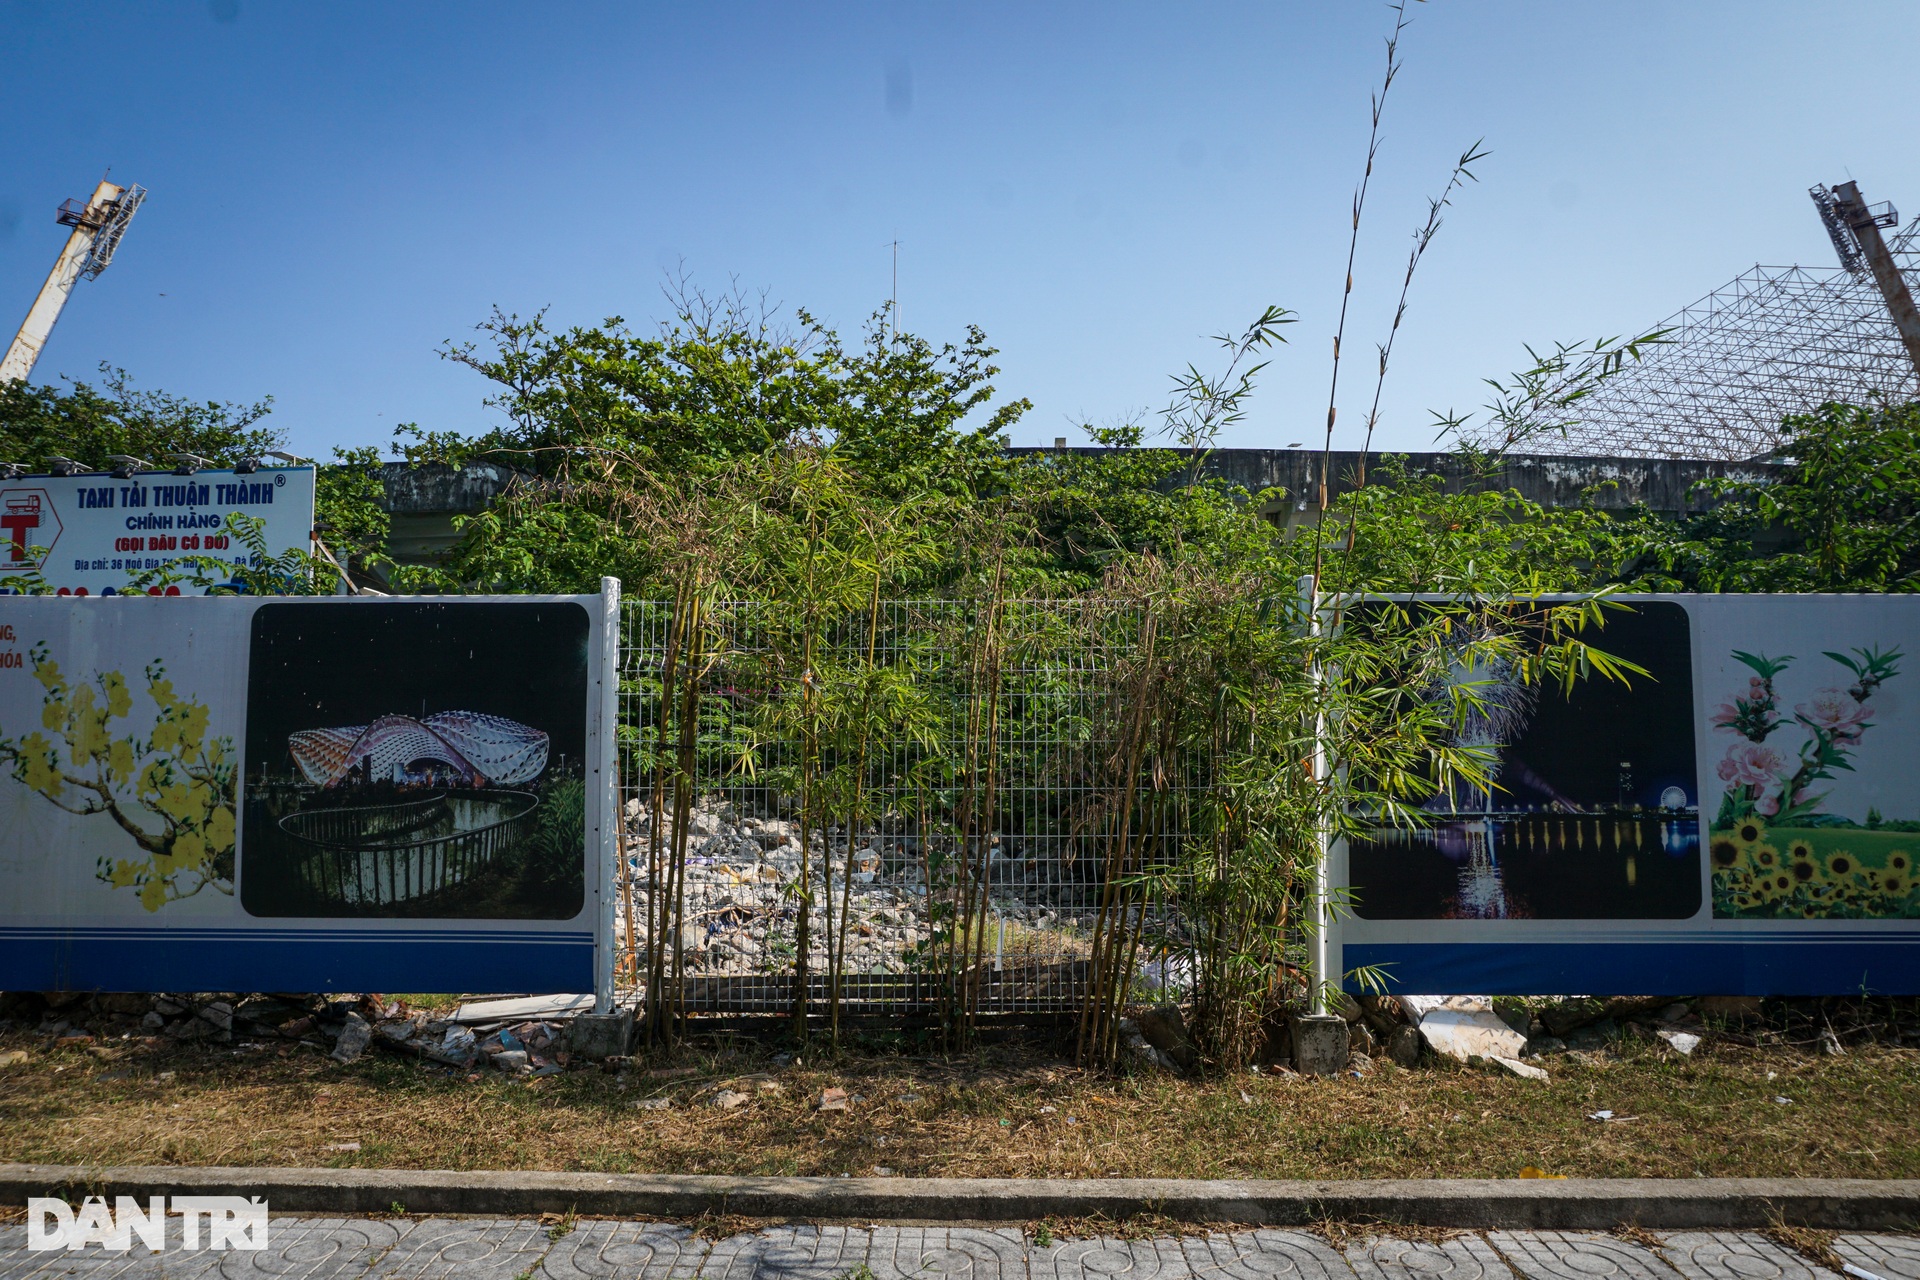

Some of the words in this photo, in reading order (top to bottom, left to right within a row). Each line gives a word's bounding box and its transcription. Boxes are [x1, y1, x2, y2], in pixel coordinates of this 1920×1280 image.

[77, 487, 115, 509] TAXI
[121, 481, 148, 508] TẢI
[153, 481, 210, 510] THUẬN
[126, 512, 173, 531] CHÍNH
[115, 536, 144, 554] (GỌI
[148, 534, 177, 551] ĐÂU
[181, 533, 200, 550] CÓ
[74, 559, 89, 573] Địa
[92, 557, 108, 570] chỉ:
[111, 559, 123, 570] 36
[145, 558, 159, 569] Gia
